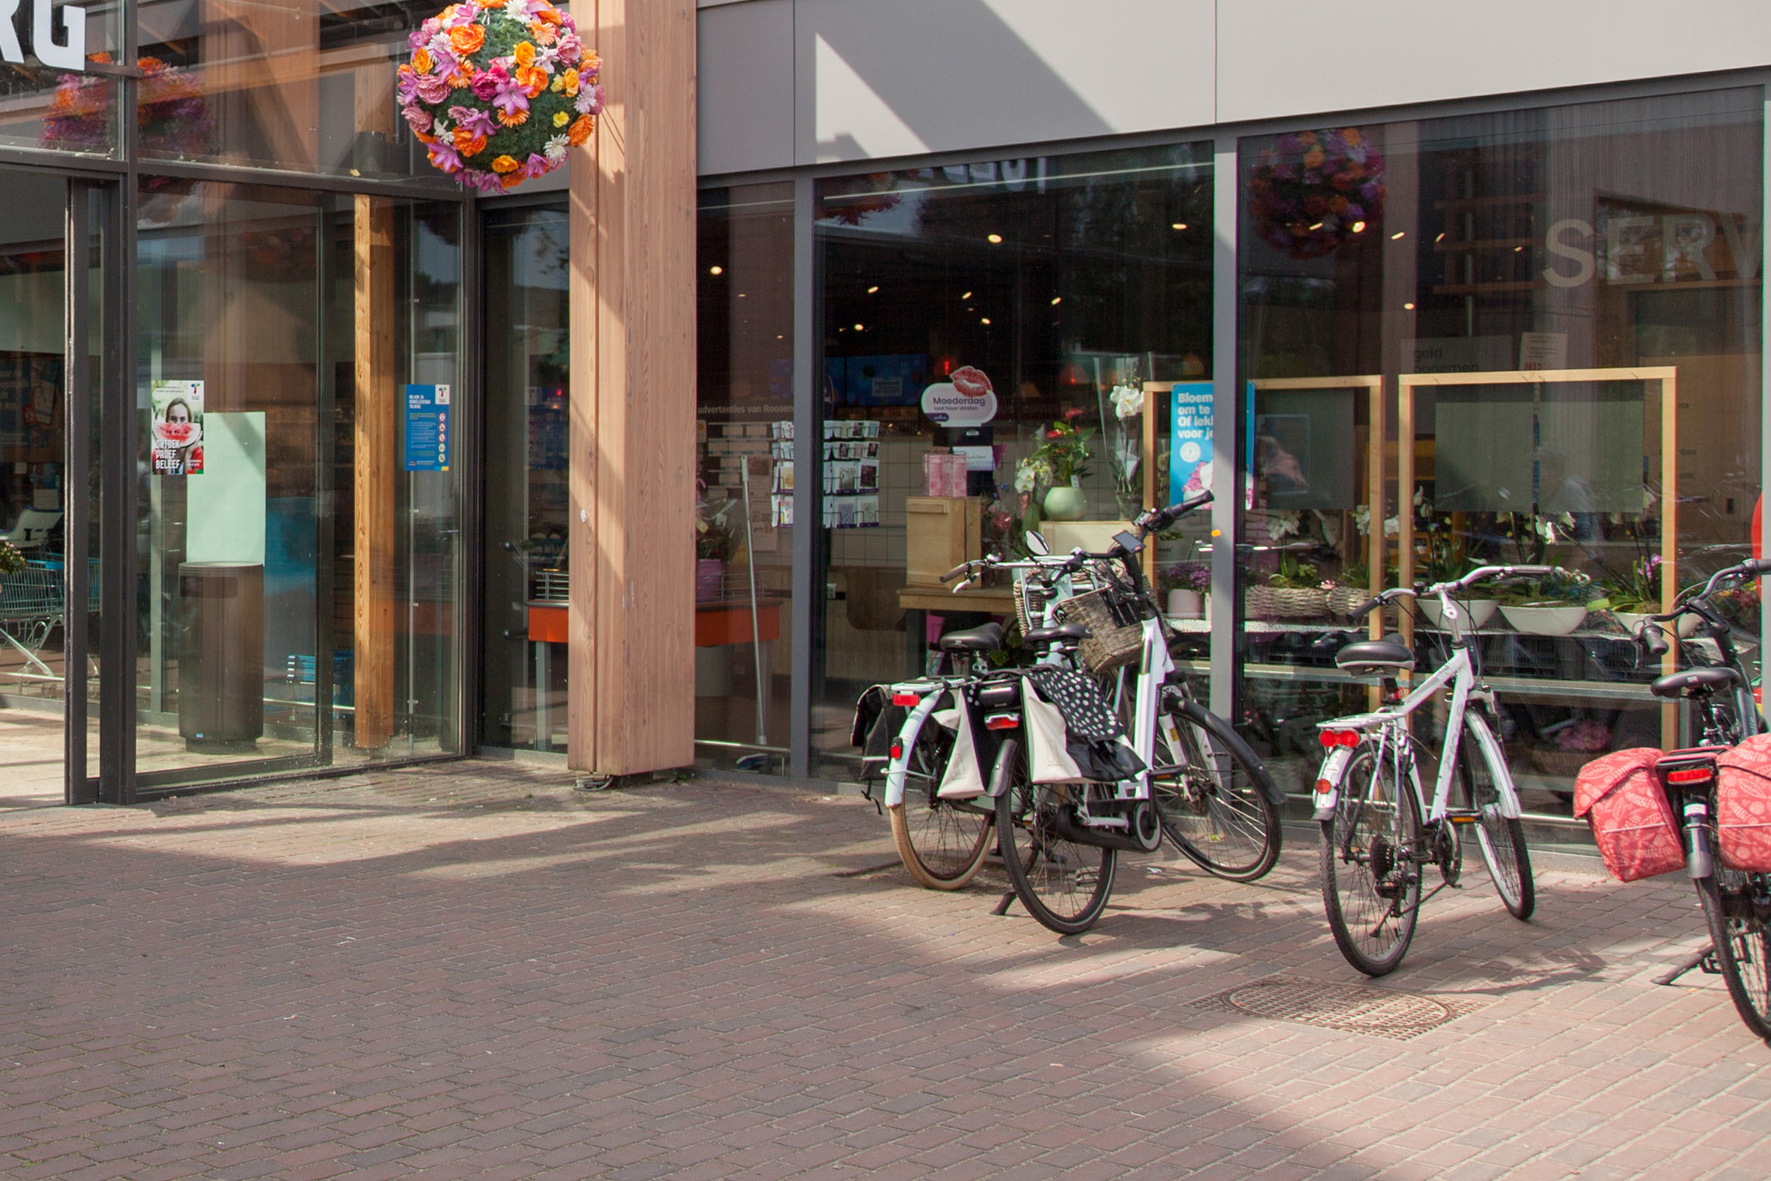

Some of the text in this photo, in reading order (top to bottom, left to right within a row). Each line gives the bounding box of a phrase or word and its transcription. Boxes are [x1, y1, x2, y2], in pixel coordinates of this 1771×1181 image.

[933, 397, 985, 407] Moederdag
[697, 405, 745, 415] advertenties
[747, 406, 762, 414] van
[1178, 404, 1211, 416] om te
[1178, 416, 1191, 427] Of
[1177, 429, 1204, 439] voor
[155, 449, 177, 459] PROEF
[155, 459, 181, 469] BELEEF
